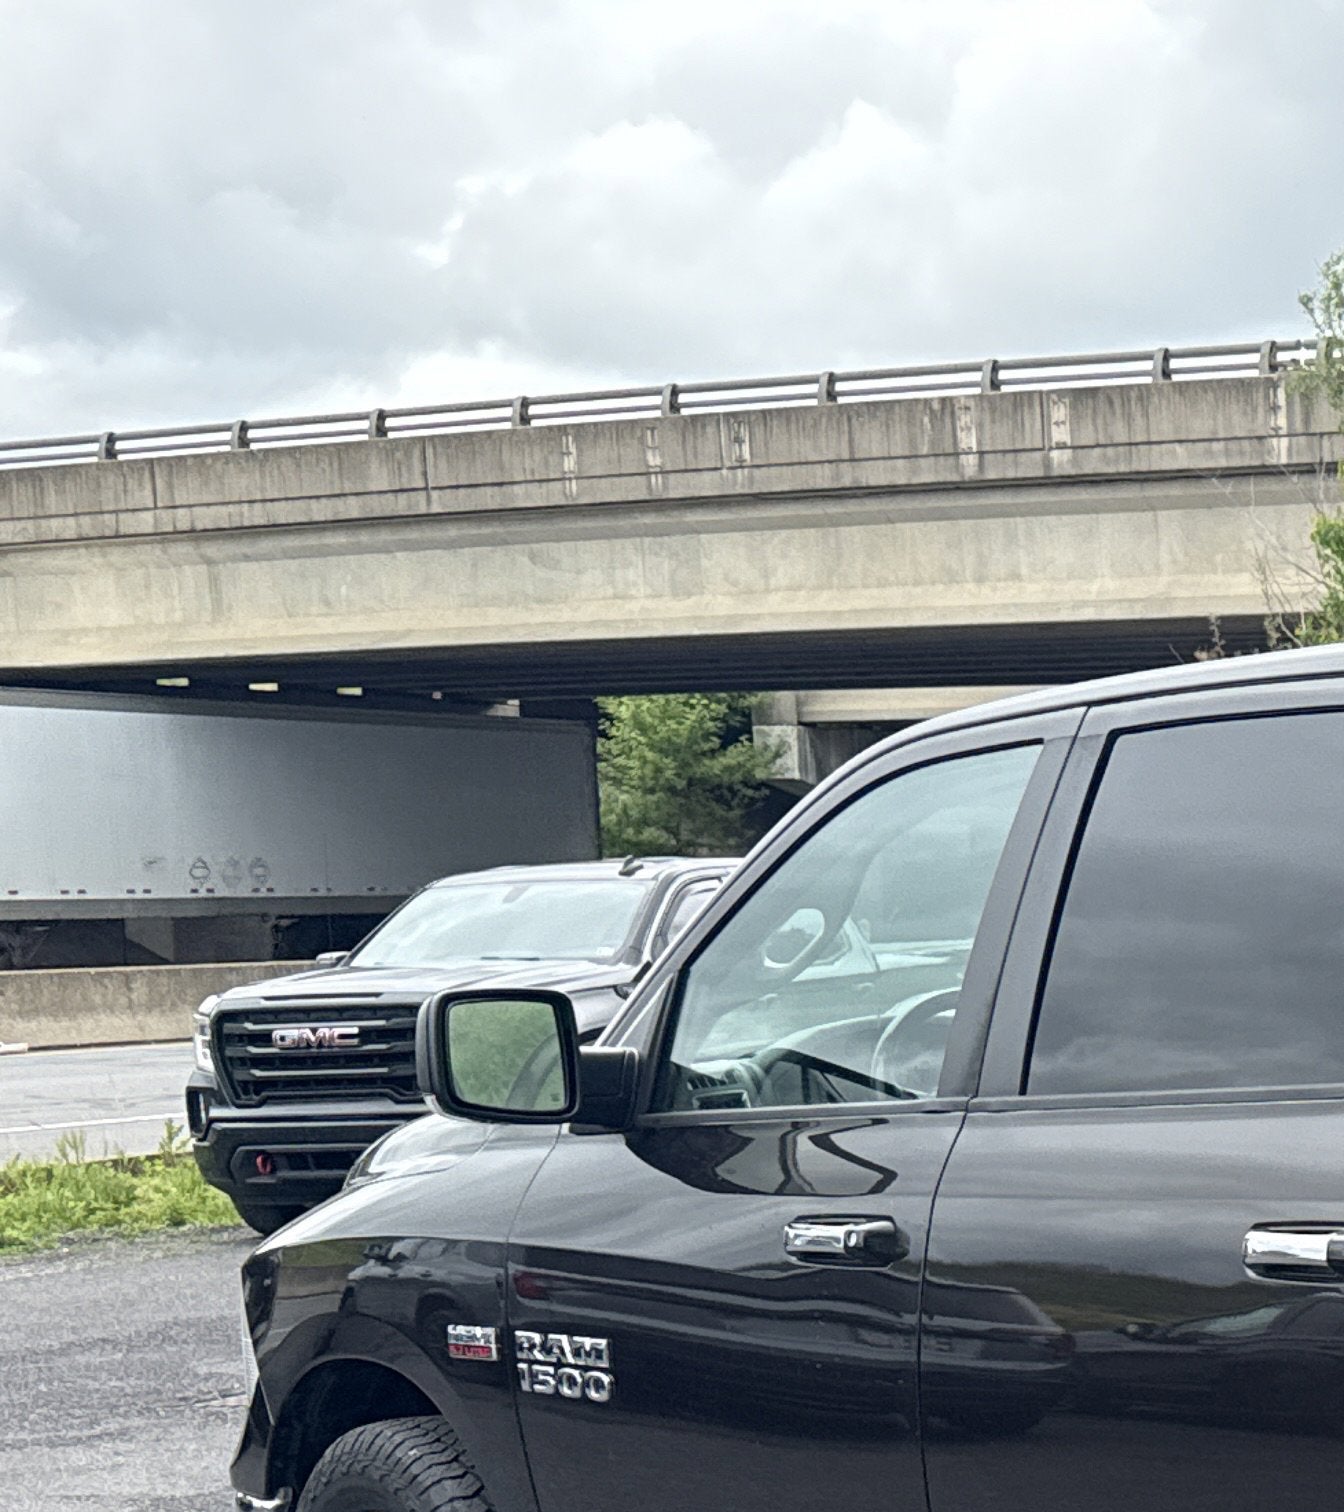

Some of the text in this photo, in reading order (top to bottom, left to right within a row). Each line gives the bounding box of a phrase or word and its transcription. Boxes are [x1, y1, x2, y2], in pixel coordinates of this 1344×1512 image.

[271, 1026, 360, 1048] GMC
[514, 1330, 610, 1368] RAM
[516, 1363, 615, 1402] 1500
